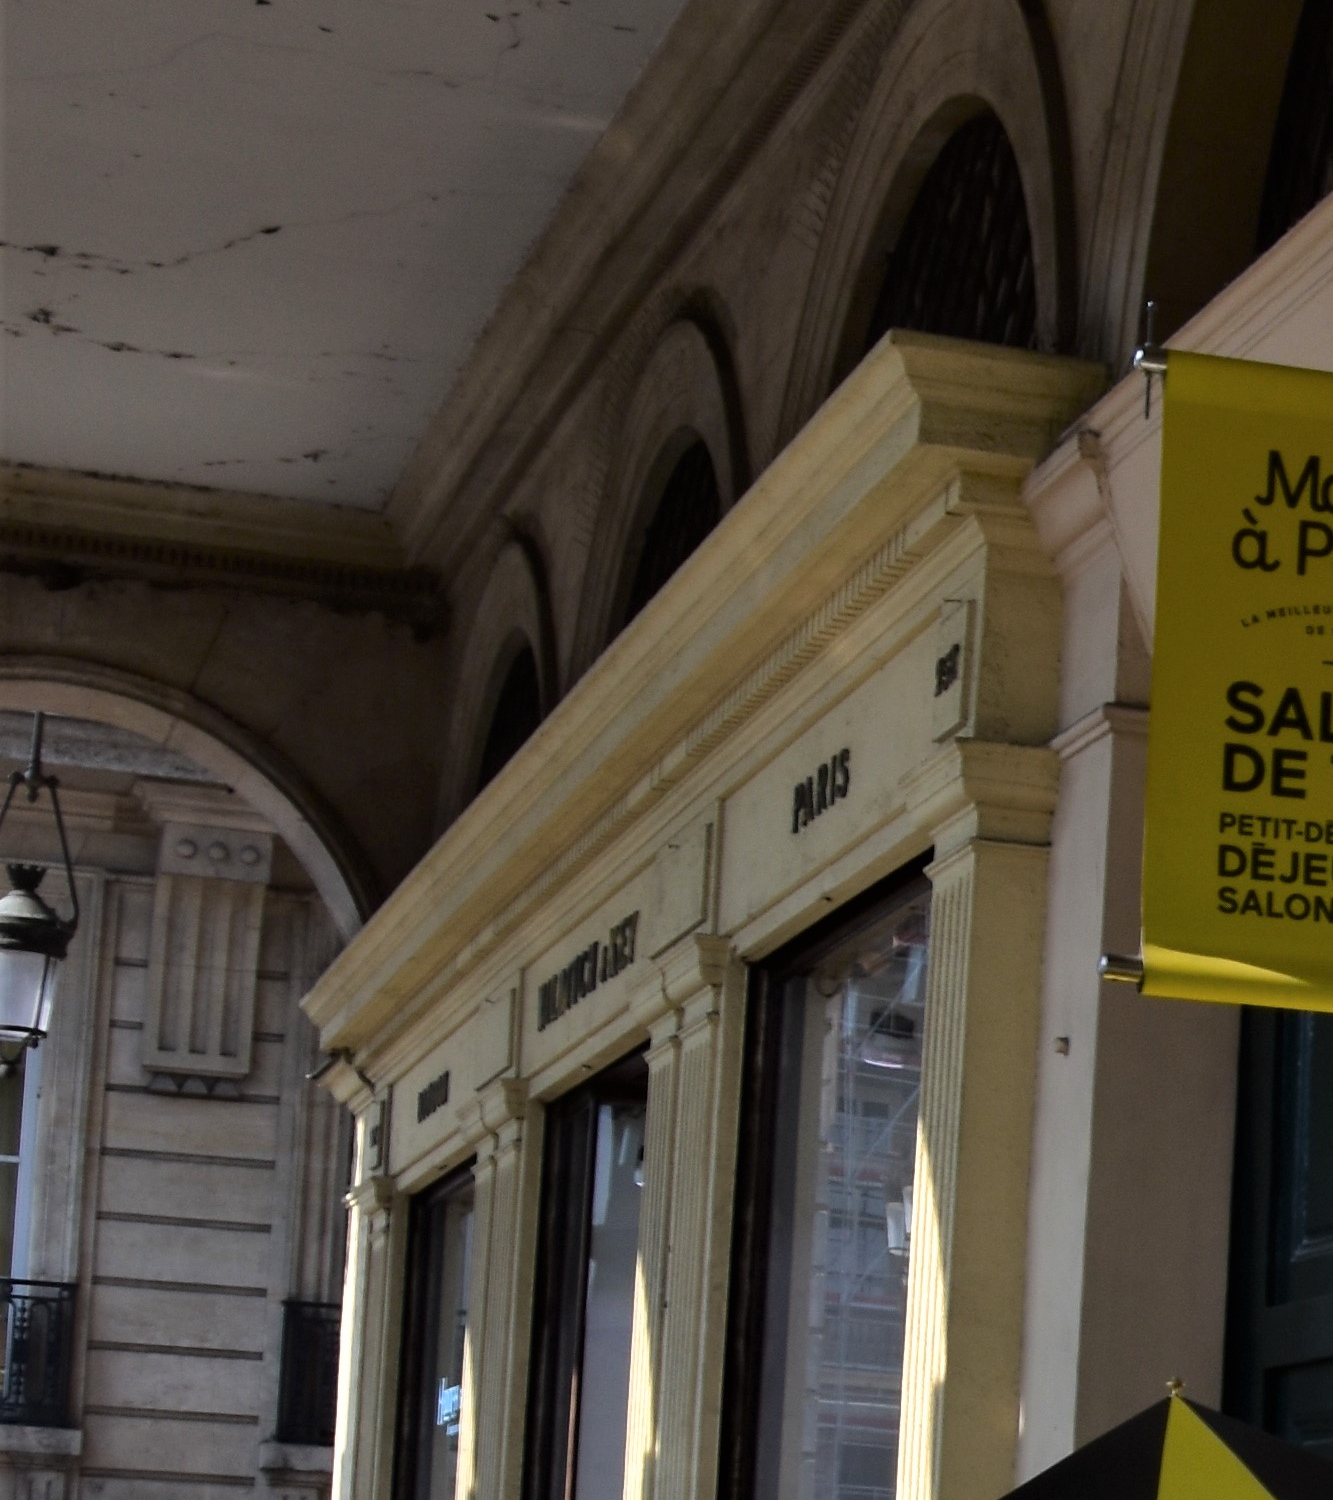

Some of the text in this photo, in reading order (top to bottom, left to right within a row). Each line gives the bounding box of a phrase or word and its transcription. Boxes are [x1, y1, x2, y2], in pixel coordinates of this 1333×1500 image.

[1232, 508, 1280, 572] à
[1241, 614, 1260, 628] LA
[1305, 625, 1325, 636] DE
[792, 748, 851, 834] PARIS
[1222, 742, 1308, 799] DE
